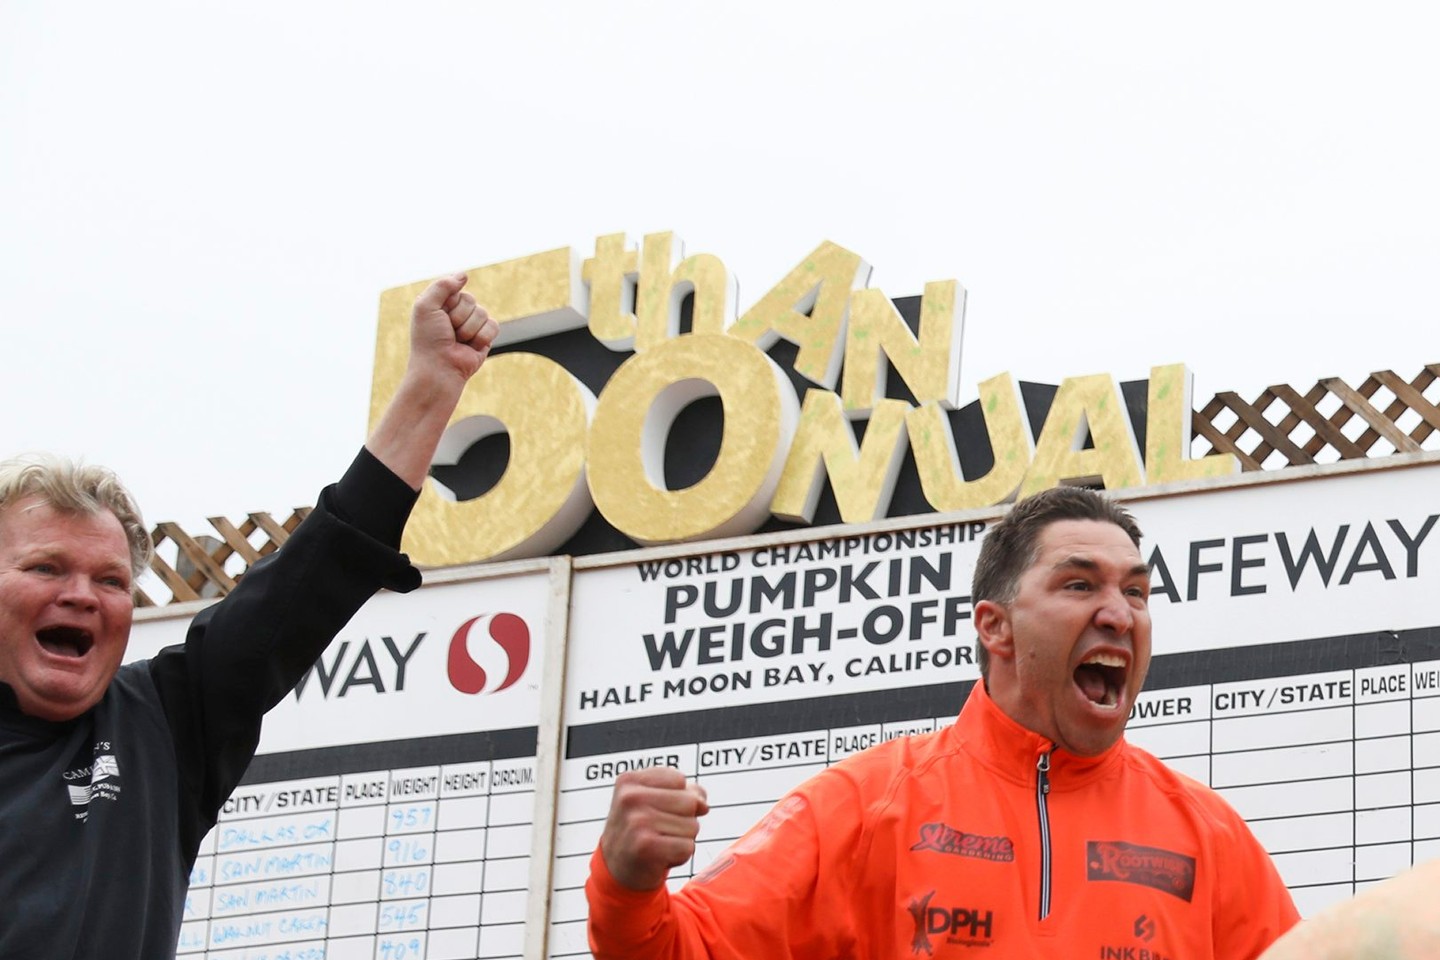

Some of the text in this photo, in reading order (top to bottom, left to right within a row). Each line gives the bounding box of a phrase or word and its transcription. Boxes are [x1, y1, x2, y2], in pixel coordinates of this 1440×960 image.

[636, 522, 986, 582] WORLD CHAMPIONSHIP
[664, 552, 954, 624] PUMPKIN
[642, 596, 972, 671] WEIGH-OFF
[579, 645, 978, 710] HALF MOON BAY, CALIFOR
[1214, 680, 1352, 711] CITY/STATE
[1361, 674, 1406, 696] PLACE
[700, 738, 827, 768] CITY/STATE
[834, 732, 878, 754] PLACE
[222, 787, 337, 814] CITY/STATE
[345, 780, 385, 799] PLACE
[392, 775, 437, 795] WEIGHT
[444, 771, 487, 791] HEIGHT
[389, 839, 427, 862] 916
[928, 907, 993, 938] DPH
